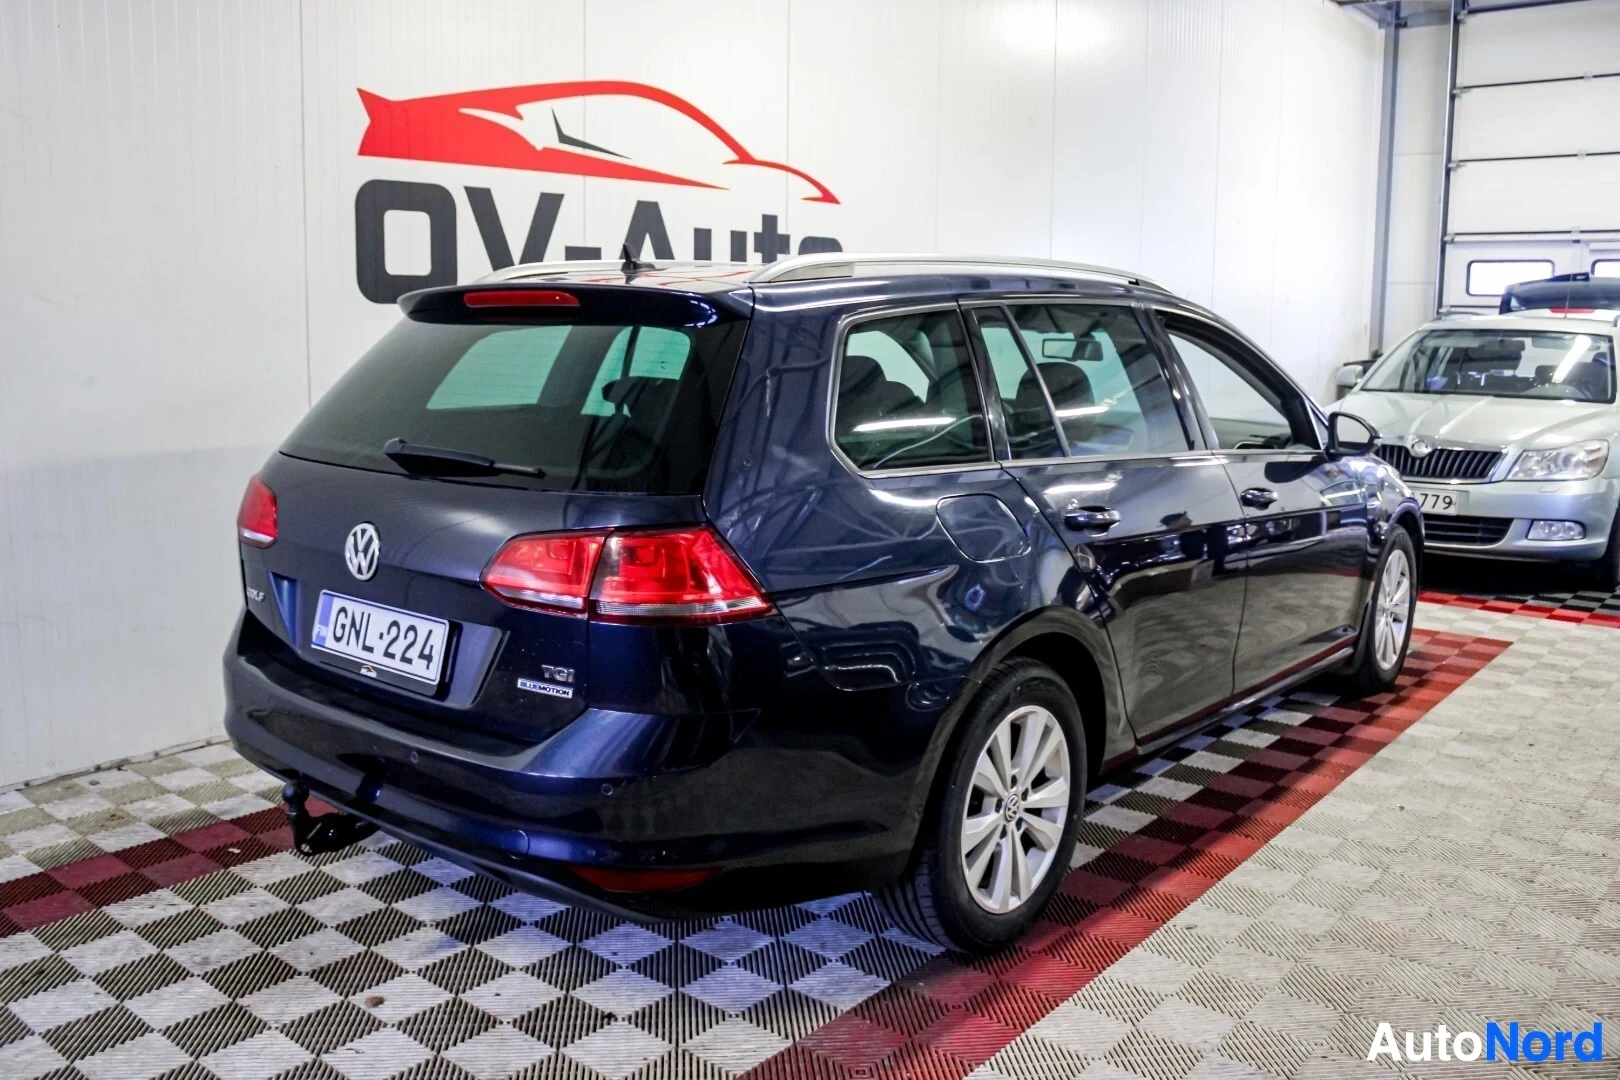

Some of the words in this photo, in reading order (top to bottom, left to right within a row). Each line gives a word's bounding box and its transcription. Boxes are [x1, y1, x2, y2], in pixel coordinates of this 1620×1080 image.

[355, 179, 844, 304] OV-At
[1412, 492, 1453, 510] 779
[541, 665, 575, 682] TGI
[520, 681, 570, 695] BLUEMOTION
